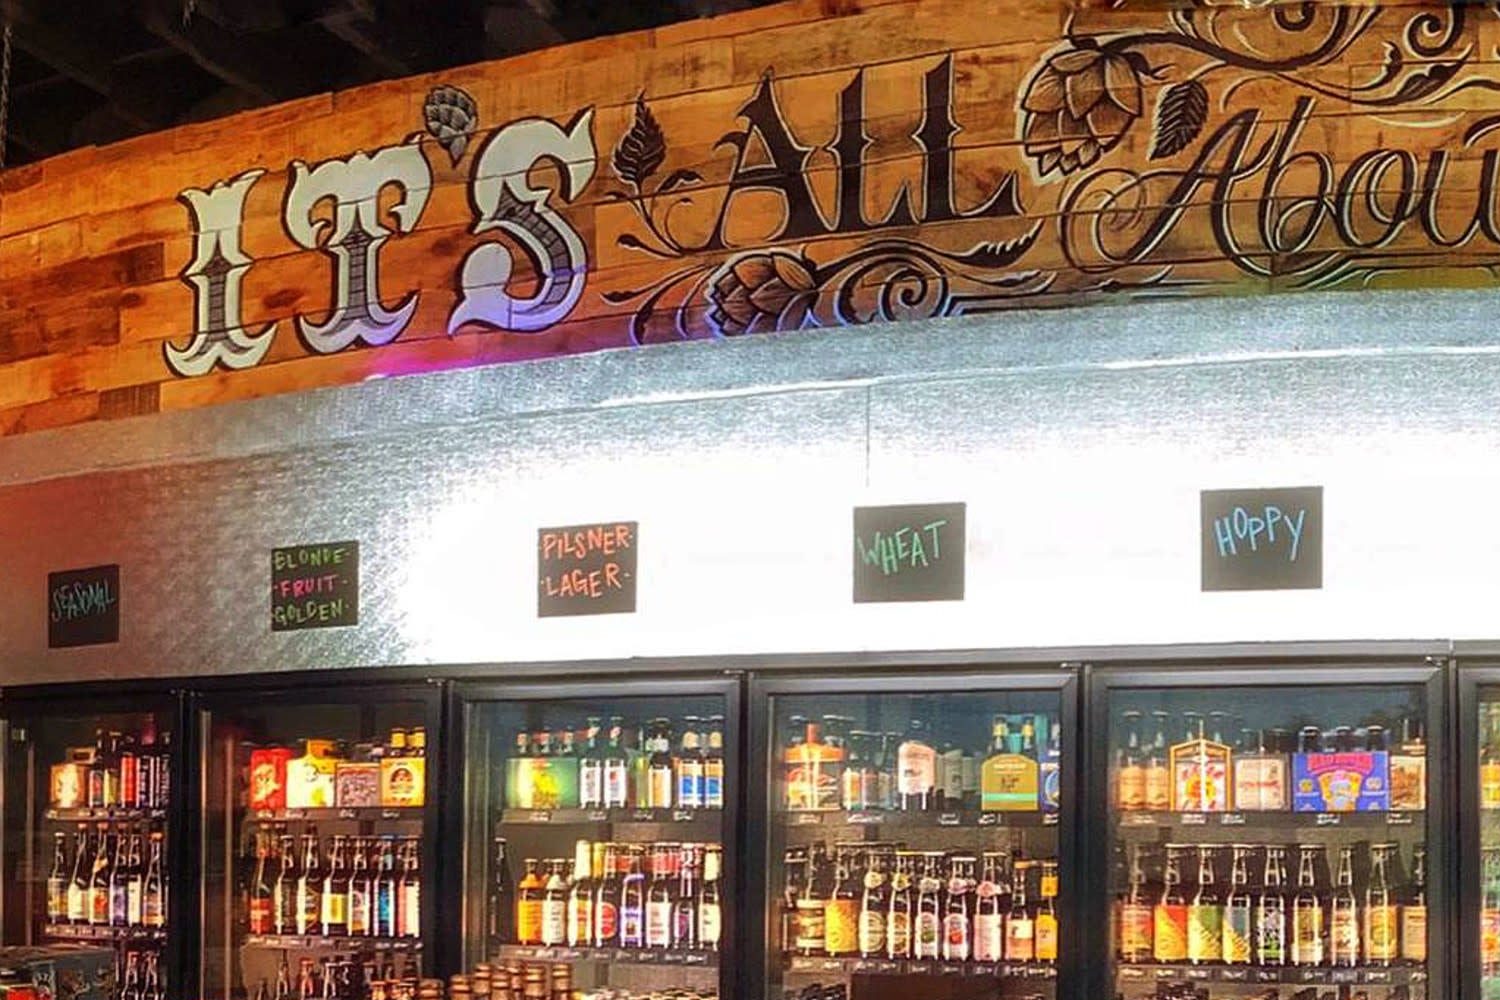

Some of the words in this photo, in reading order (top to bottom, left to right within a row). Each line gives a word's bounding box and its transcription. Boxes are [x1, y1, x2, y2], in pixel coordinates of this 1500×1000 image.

[542, 525, 629, 560] PILSNER
[856, 520, 947, 576] WHEAT
[1213, 506, 1306, 561] HOPPY
[273, 547, 345, 571] BLONDE
[278, 573, 341, 599] FRUIT
[545, 562, 622, 599] LAGER
[273, 598, 344, 627] GOLDEN
